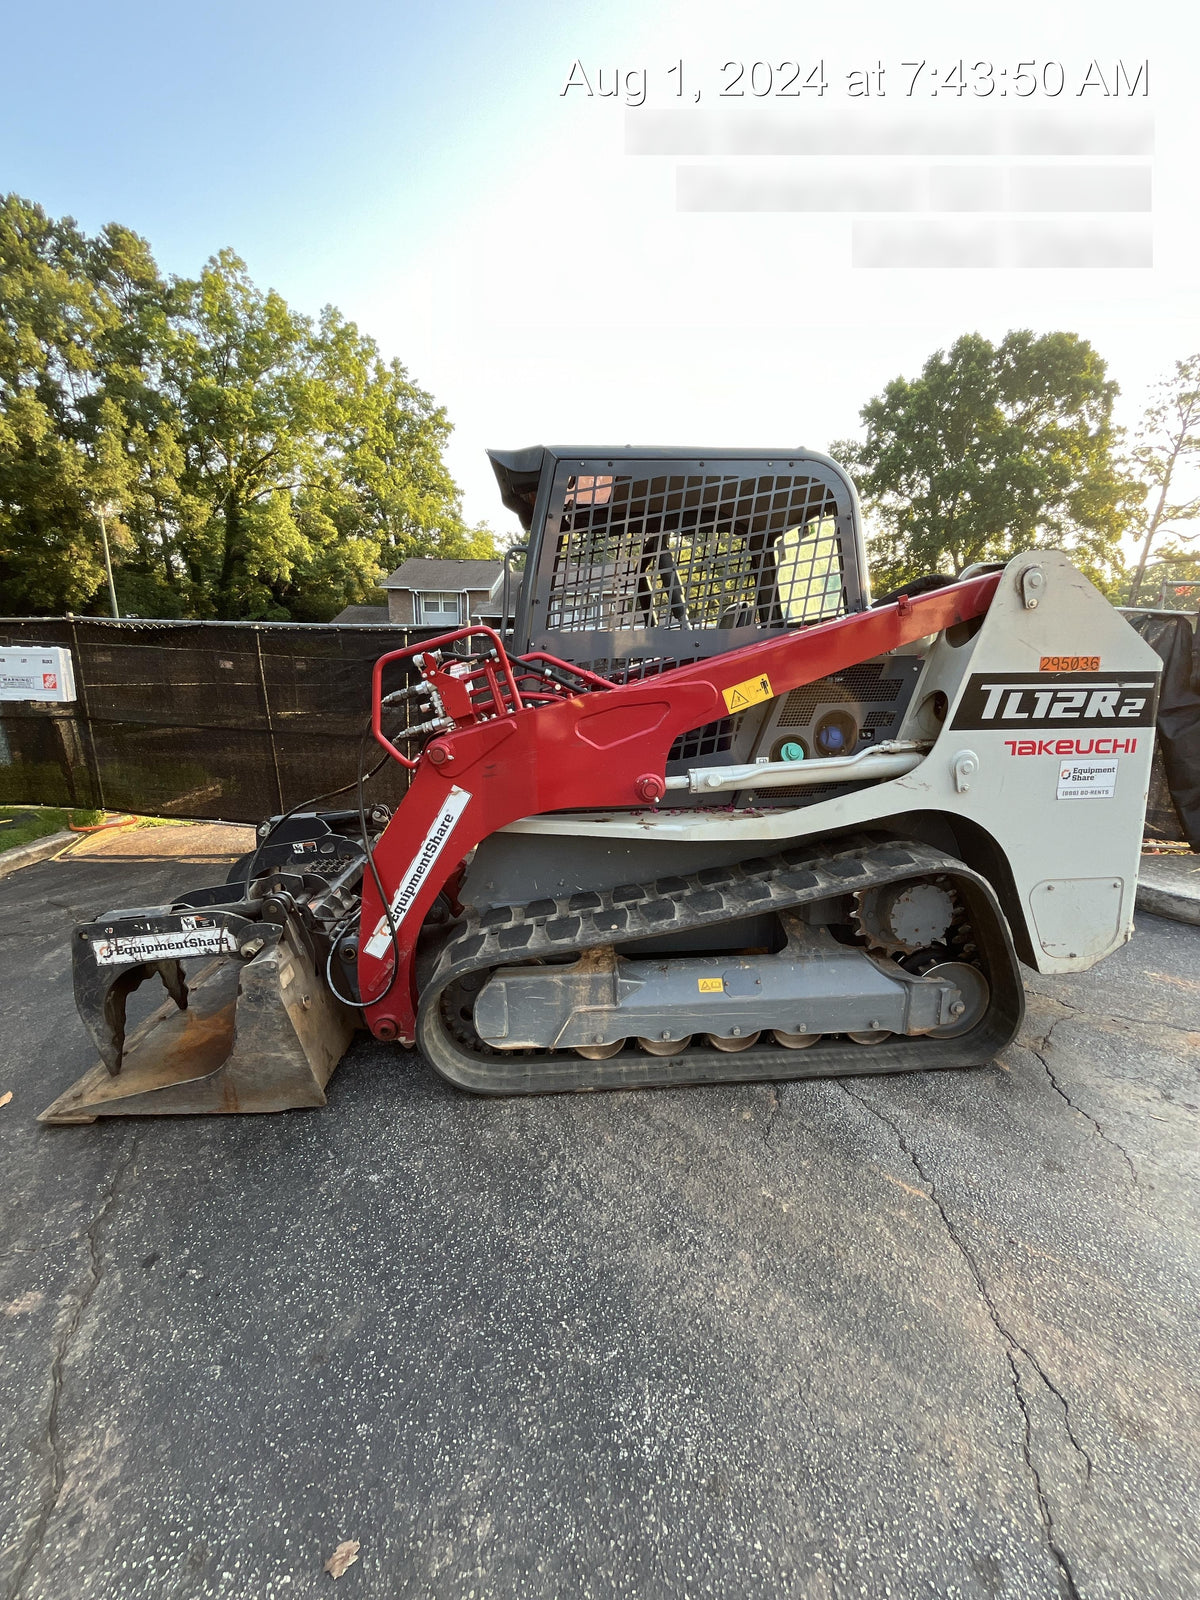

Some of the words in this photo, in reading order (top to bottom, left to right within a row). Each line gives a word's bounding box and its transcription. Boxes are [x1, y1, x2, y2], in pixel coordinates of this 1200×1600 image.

[1040, 656, 1100, 671] 295036
[1073, 766, 1116, 774] Equipment
[390, 812, 454, 924] EquipmentShare
[115, 936, 229, 957] EquipmentShare
